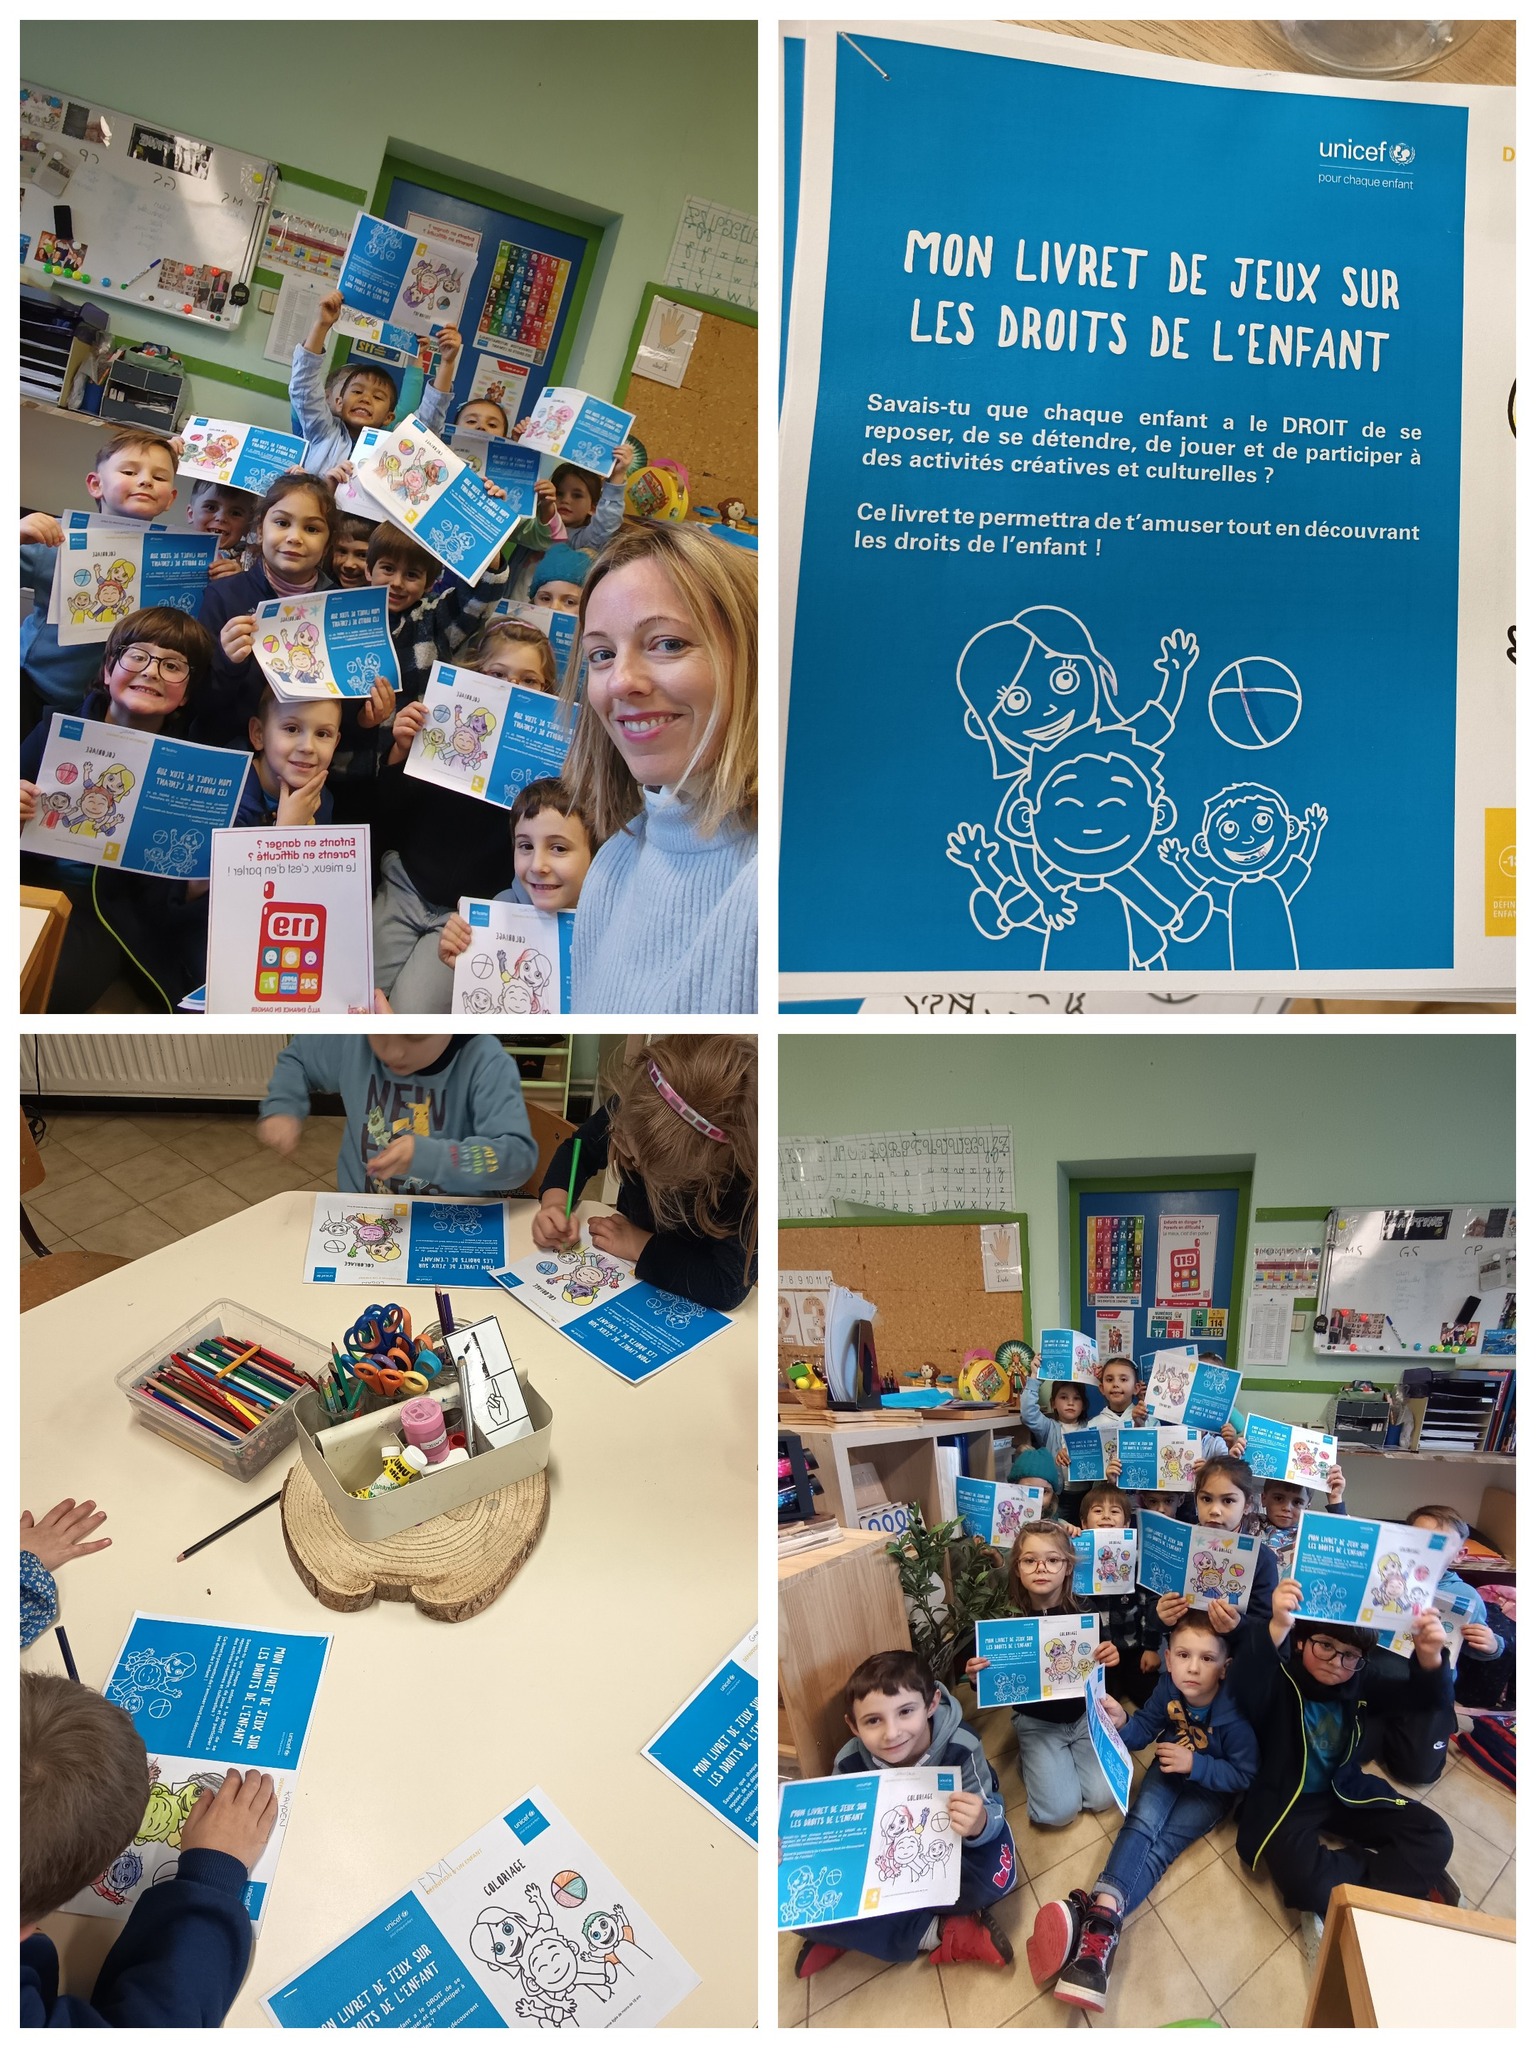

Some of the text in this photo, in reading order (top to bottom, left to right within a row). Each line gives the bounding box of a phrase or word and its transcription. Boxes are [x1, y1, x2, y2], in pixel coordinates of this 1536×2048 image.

[1319, 138, 1387, 162] unicef
[1502, 146, 1515, 163] D
[1317, 173, 1413, 190] pour chaque enfant
[903, 229, 1399, 309] MON LIVRET DE JEUX SUR
[910, 298, 1388, 370] LES DROITS DE L'ENFANT
[867, 393, 1422, 440] Savais-tu que chaque enfant a le DROIT de se
[864, 424, 1421, 467] reposer, de se détendre, de jouer et de participer à
[861, 447, 1274, 484] des activités créatives et culturelles ?
[856, 501, 1419, 540] Ce livret te permettra de t'amuser tout en découvrant
[854, 529, 1101, 556] les droits de l'enfant !
[1175, 1254, 1195, 1266] 119
[1154, 1329, 1163, 1338] 17
[1171, 1329, 1180, 1338] 18
[1209, 1319, 1223, 1328] 114
[1209, 1328, 1223, 1336] 112
[388, 1467, 401, 1482] stic
[231, 1646, 270, 1745] LES DROITS DE L'ENFANT
[245, 1646, 286, 1749] MON LIVRET DE JEUX SUR
[285, 1731, 293, 1750] unicef
[692, 1757, 712, 1777] MON
[706, 1733, 730, 1760] LIVRET
[726, 1724, 740, 1738] DE
[734, 1707, 754, 1728] JEUX
[707, 1737, 752, 1787] LES DROITS DE
[513, 1813, 530, 1829] unicef
[483, 1859, 526, 1896] COLORIAGE
[384, 1914, 402, 1931] unicef
[337, 1943, 432, 2023] LIVRET DE JEUX SUR
[379, 1961, 438, 2015] DE L'ENFANT
[425, 1990, 443, 2007] DROIT
[436, 1987, 460, 2010] participer
[450, 2002, 479, 2029] découvrant
